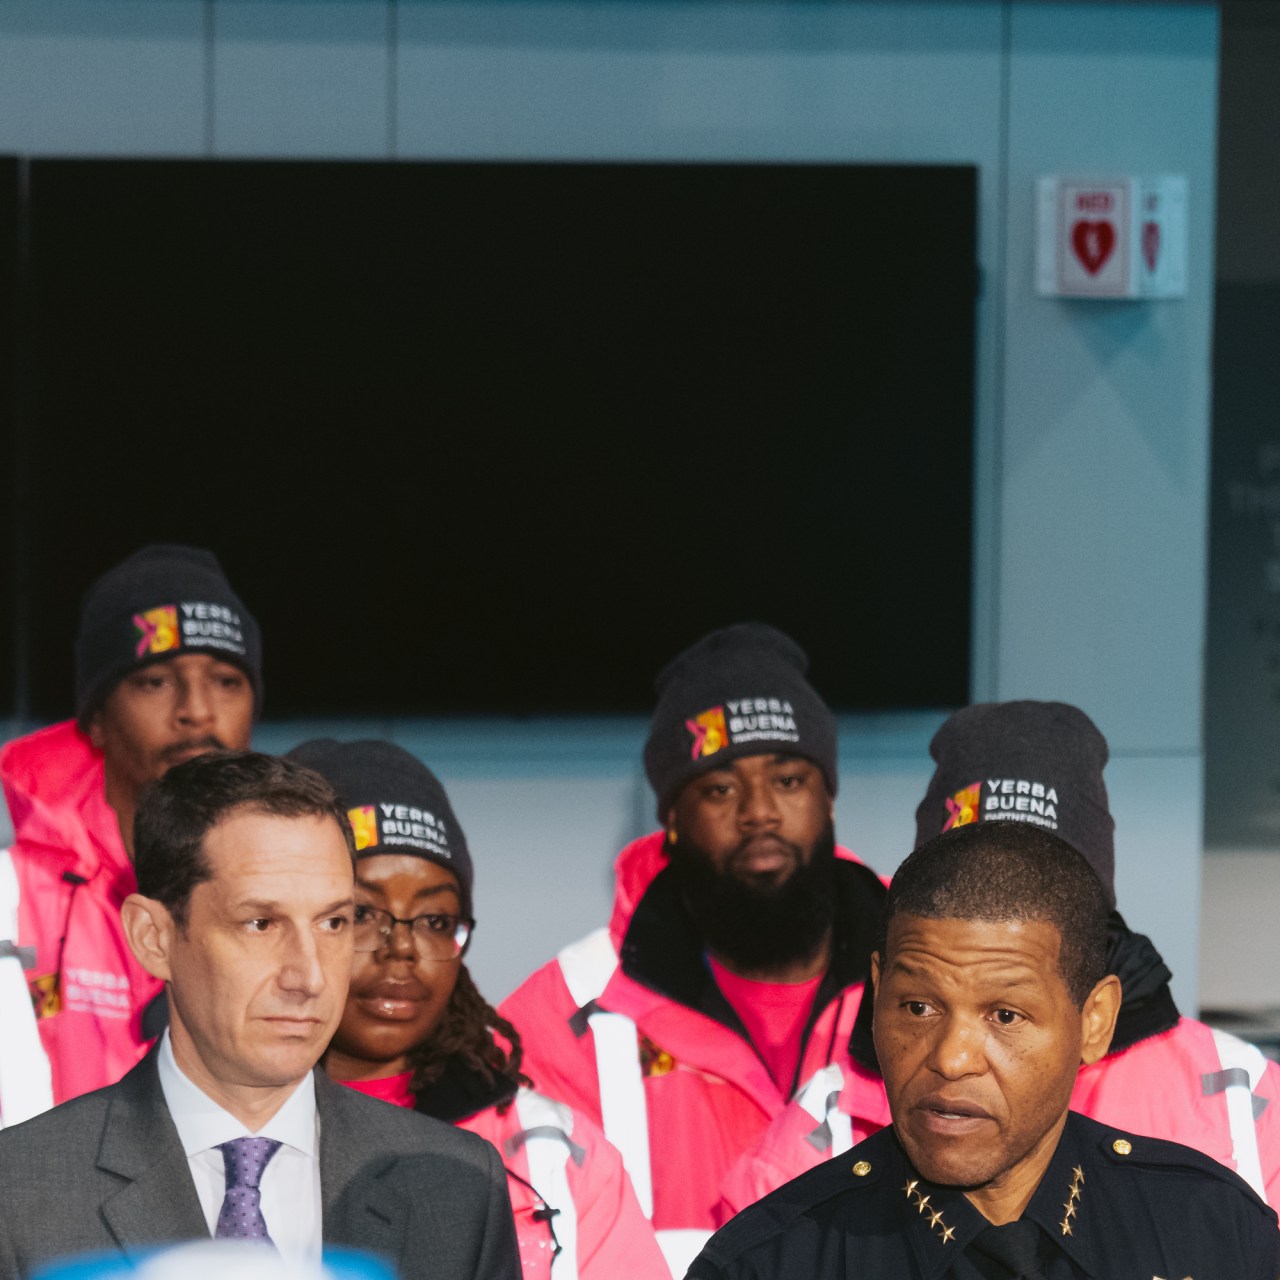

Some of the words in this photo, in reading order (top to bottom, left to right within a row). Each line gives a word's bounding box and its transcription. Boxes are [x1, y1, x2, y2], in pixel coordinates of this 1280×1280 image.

[181, 603, 240, 625] YERBA
[183, 620, 243, 642] BUENA
[726, 698, 794, 716] YERBA
[730, 714, 798, 733] BUENA
[987, 779, 1058, 805] YERBA
[380, 803, 446, 834] YERBA
[985, 795, 1057, 820] BUENA
[383, 820, 448, 846] BUENA
